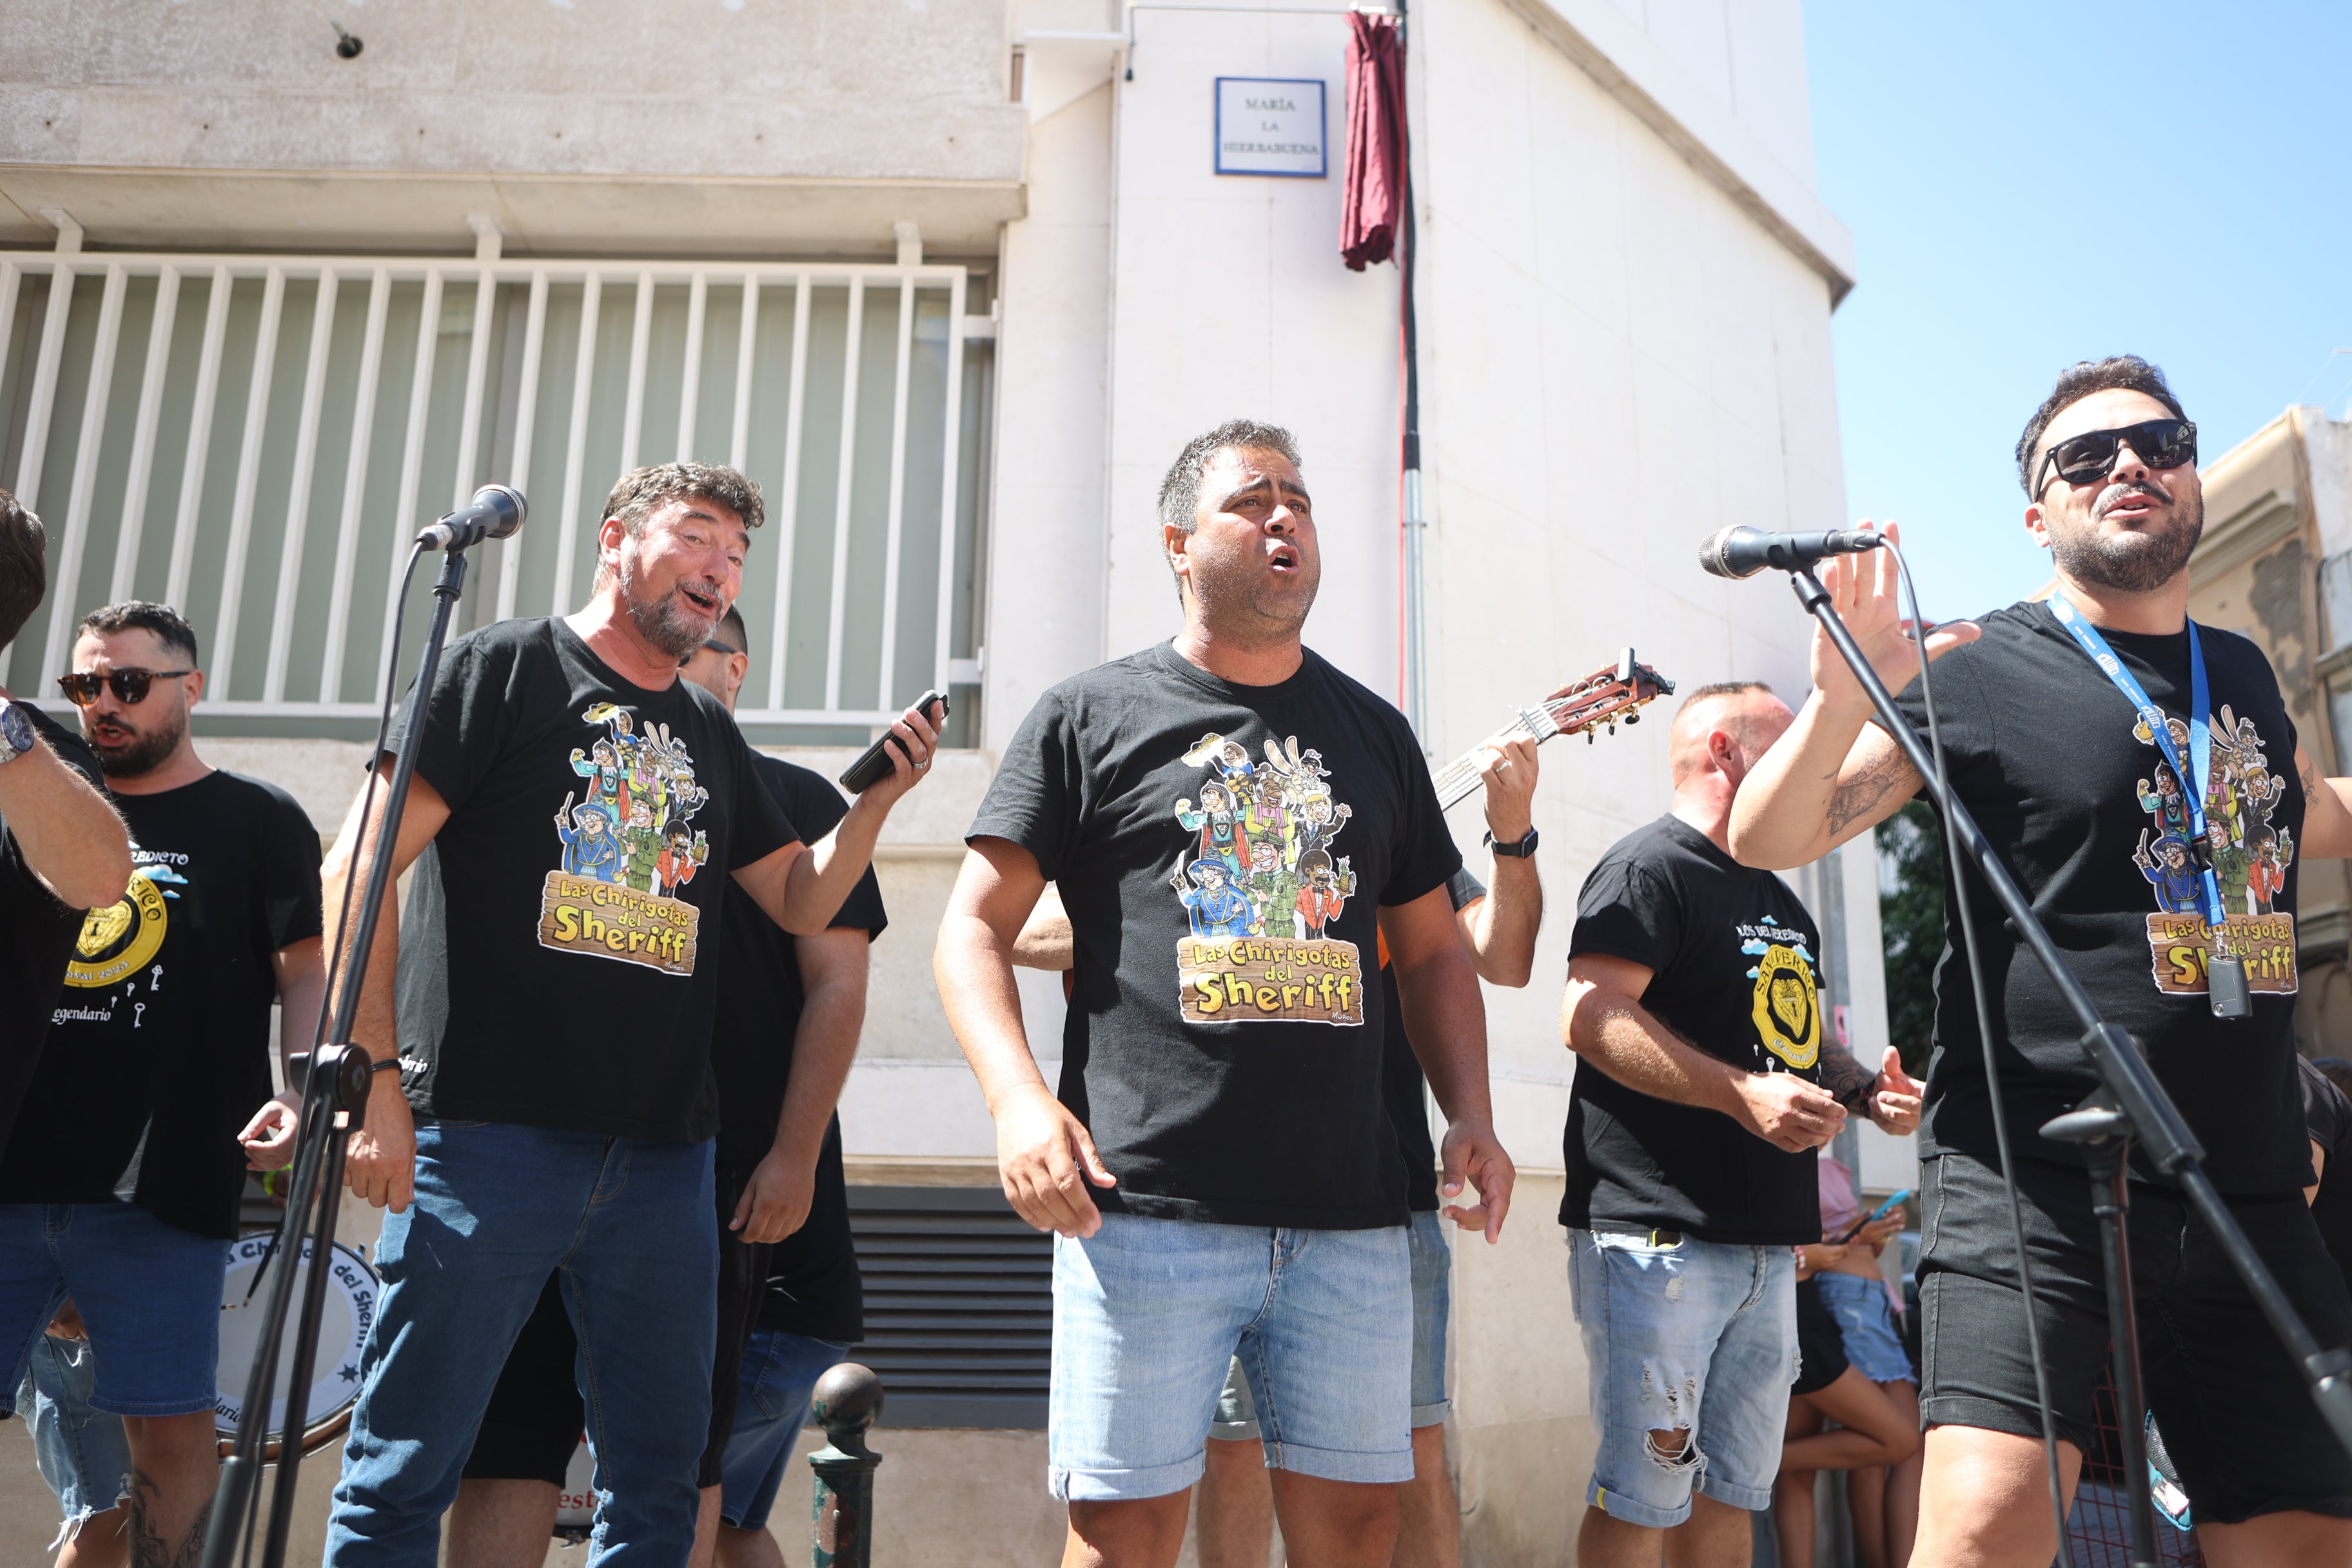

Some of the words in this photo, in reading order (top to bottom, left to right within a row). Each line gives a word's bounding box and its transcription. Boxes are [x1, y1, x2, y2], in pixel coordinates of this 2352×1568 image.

[1245, 97, 1296, 112] MARÍA
[1261, 121, 1280, 132] LA
[130, 850, 189, 865] REDICTO
[131, 877, 161, 921] RICO
[560, 879, 589, 899] Las
[591, 884, 689, 927] Chirigotas
[617, 912, 642, 928] del
[2164, 919, 2195, 939] Las
[553, 904, 687, 963] Sheriff
[1736, 924, 1756, 937] LOS
[1193, 944, 1226, 965] Las
[1228, 940, 1351, 970] Chirigotas
[2228, 939, 2252, 956] del
[1264, 965, 1293, 983] del
[2167, 945, 2291, 986] Sriff
[66, 971, 93, 981] aval
[1193, 971, 1352, 1014] Sheriff
[52, 1005, 111, 1025] egendario
[333, 1264, 364, 1289] del
[558, 1489, 601, 1509] est
